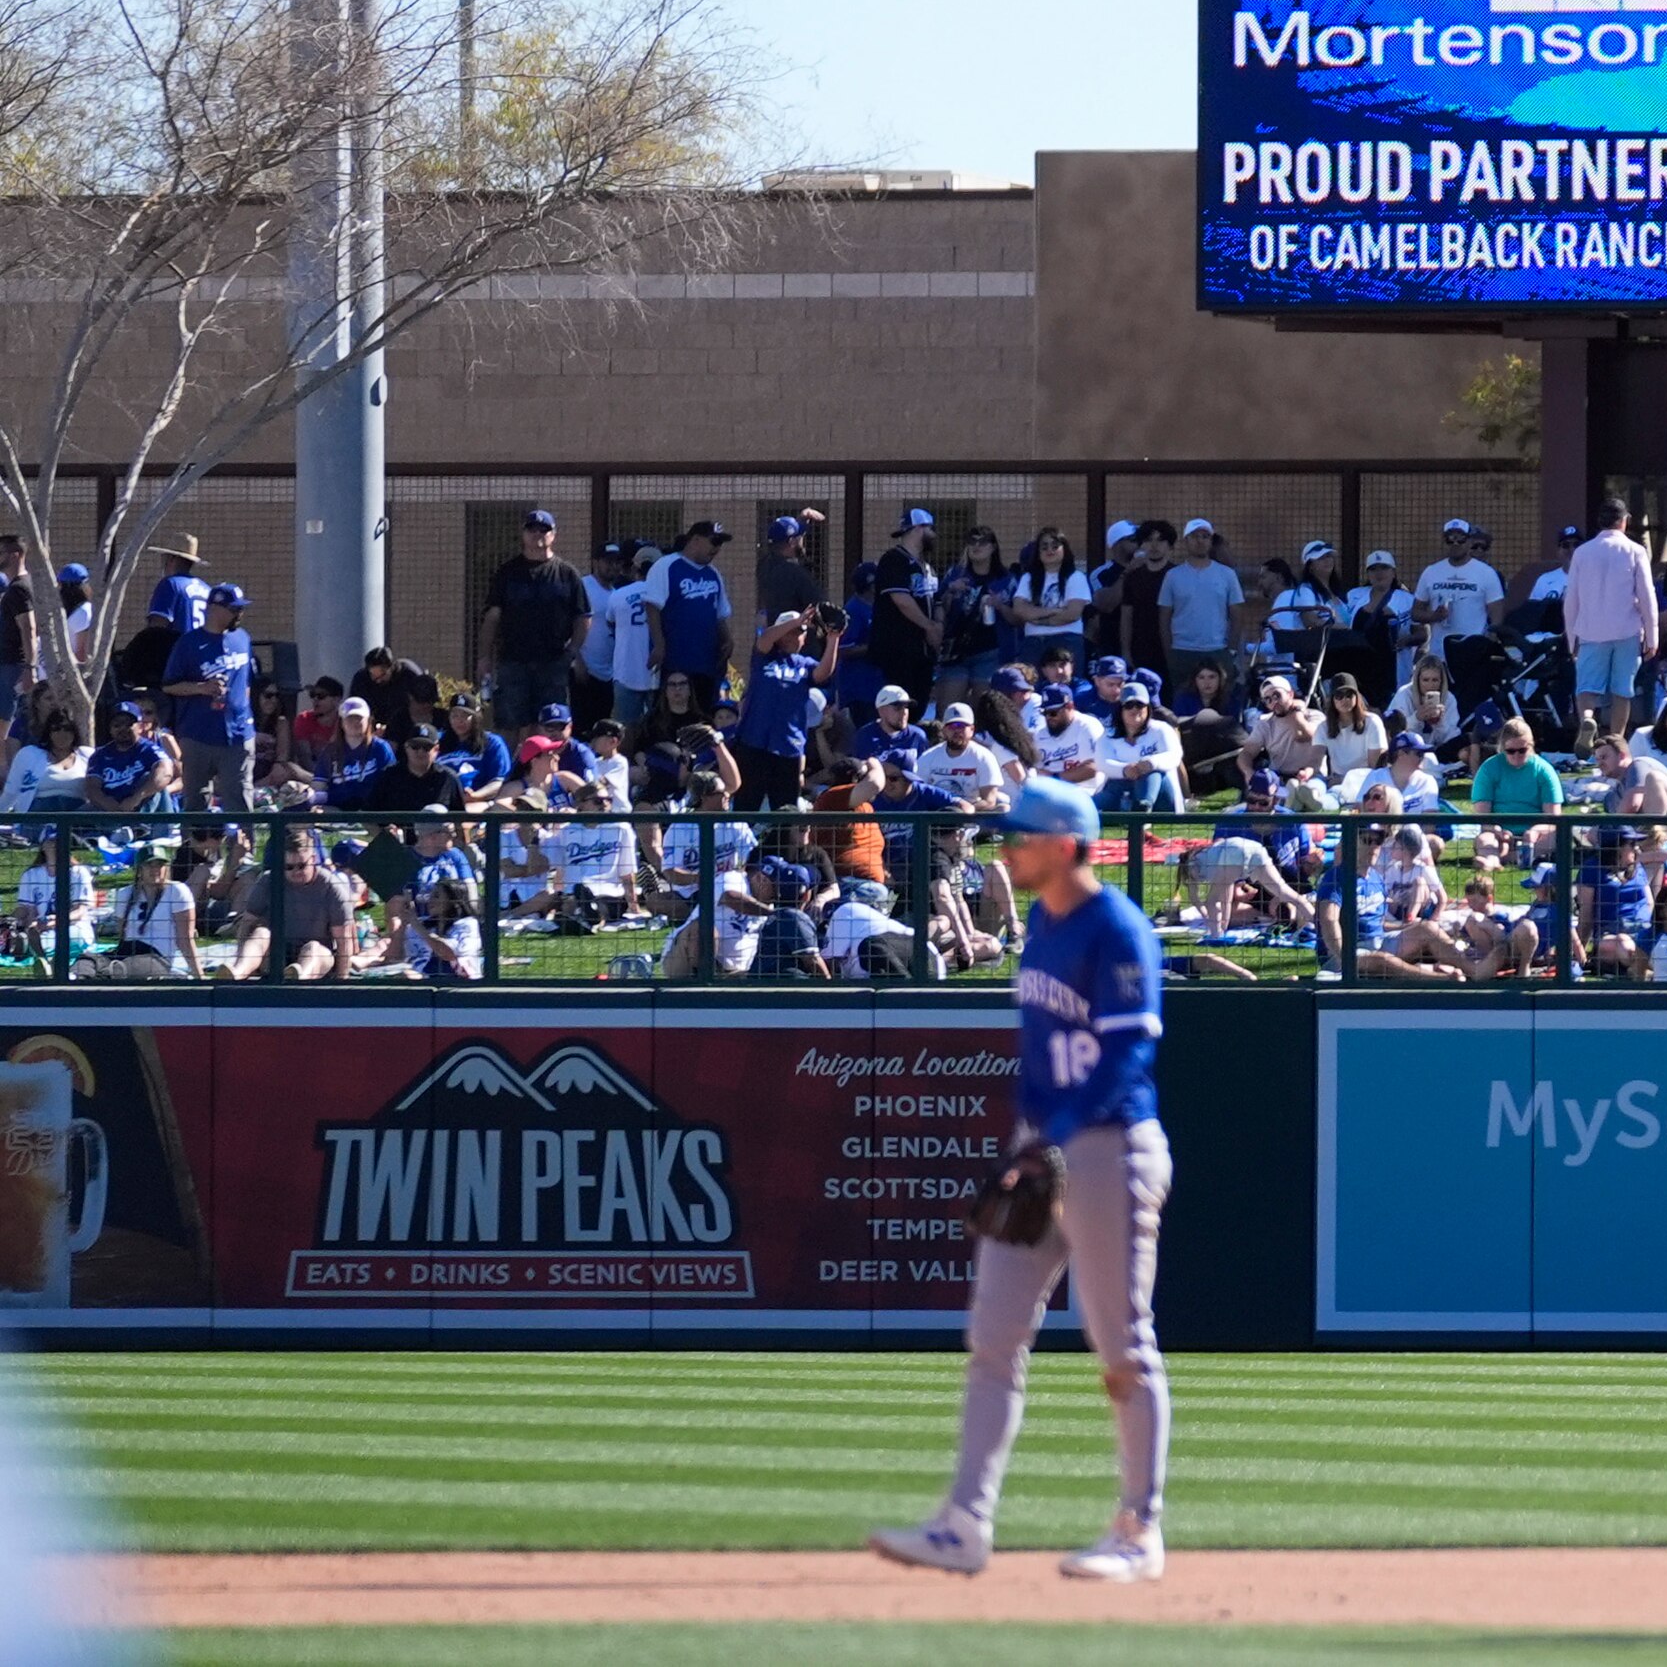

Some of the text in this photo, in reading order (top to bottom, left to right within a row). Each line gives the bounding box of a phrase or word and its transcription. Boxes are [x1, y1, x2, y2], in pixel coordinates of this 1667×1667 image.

[1223, 140, 1414, 203] PROUD
[1248, 223, 1299, 270] OF
[1309, 222, 1546, 270] CAMELBACK
[1433, 582, 1478, 592] CHAMPIONS
[796, 1047, 1022, 1087] Arizona Location
[854, 1095, 986, 1119] PHOENIX
[841, 1136, 998, 1159] GLENDALE
[322, 1128, 733, 1244] TWIN PEAKS
[824, 1177, 979, 1200] SCOTTSDA
[867, 1218, 965, 1241] TEMPE
[306, 1263, 738, 1286] EATS DRINKS SCENIC VIEWS
[819, 1259, 979, 1282] DEER VALL
